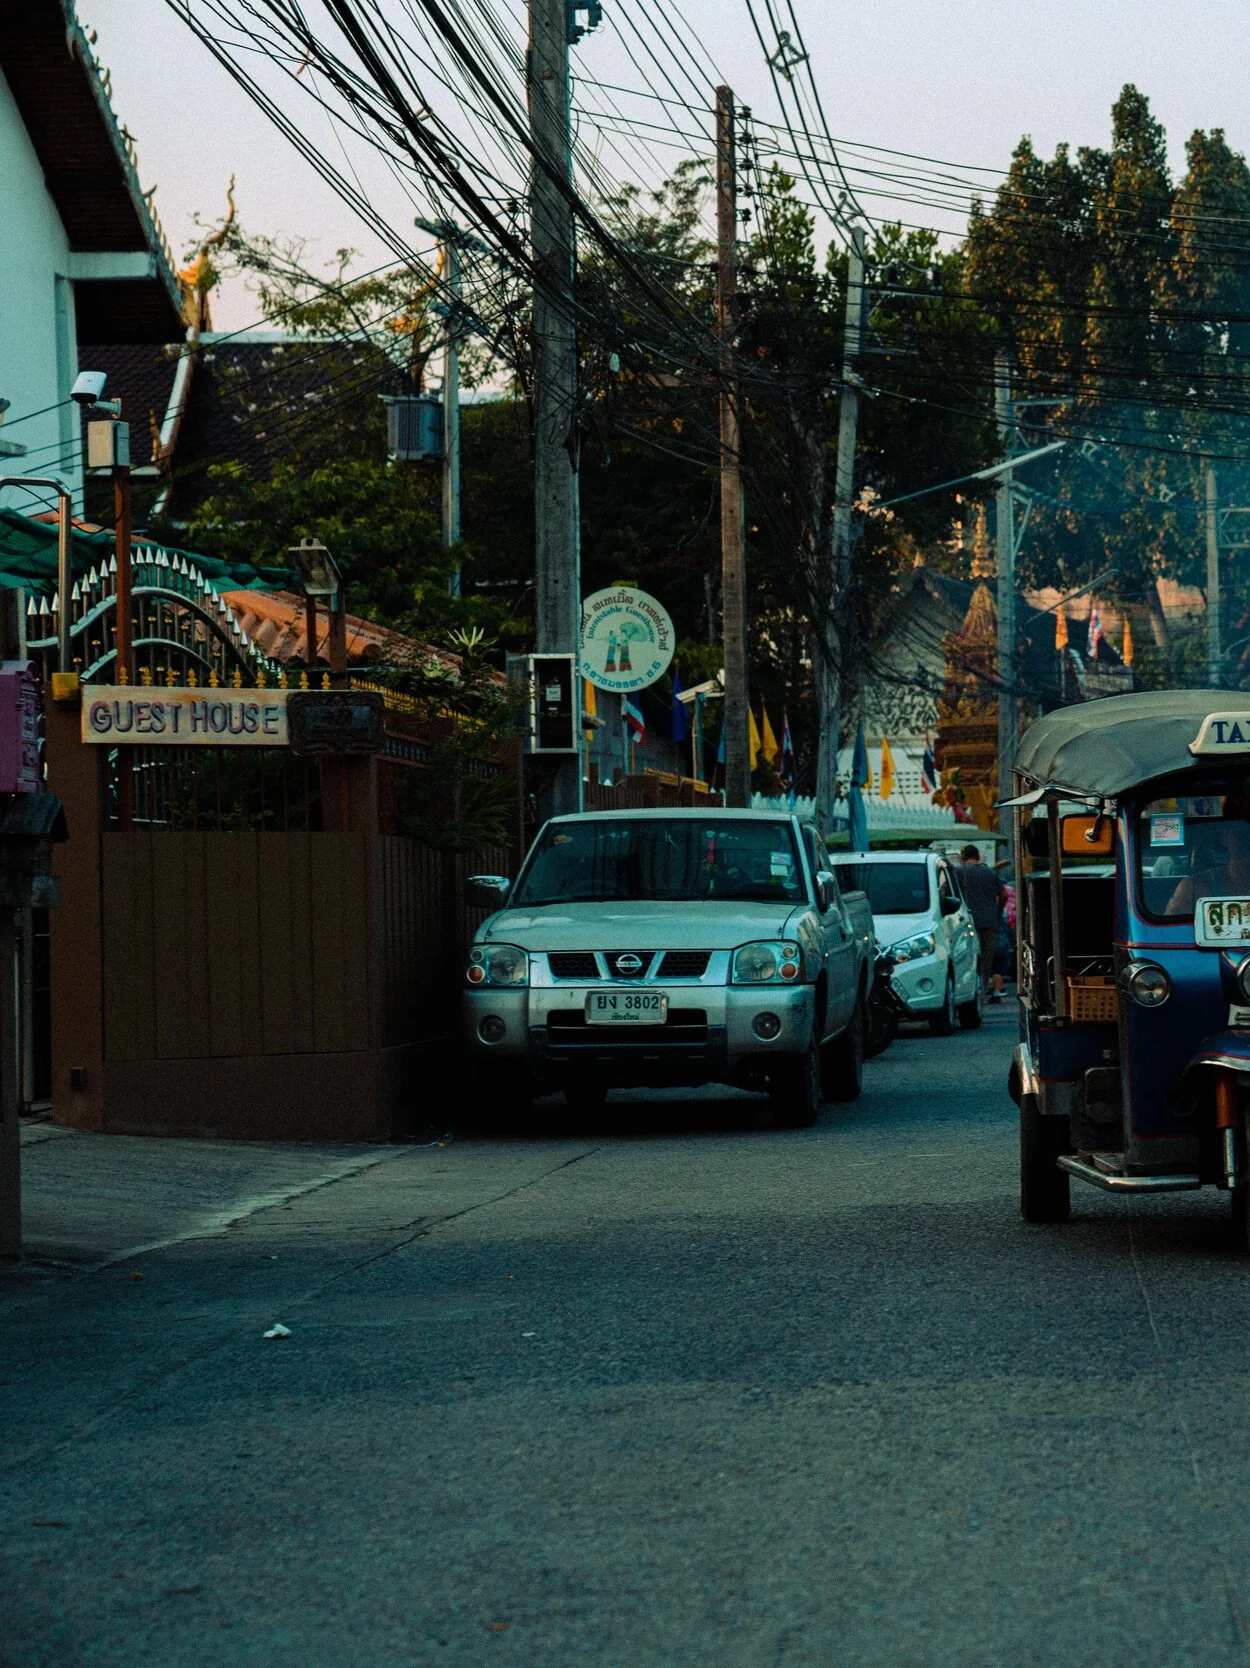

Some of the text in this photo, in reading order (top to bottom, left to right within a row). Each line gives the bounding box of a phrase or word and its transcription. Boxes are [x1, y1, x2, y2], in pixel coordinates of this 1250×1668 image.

[625, 605, 656, 644] Guesthouse
[90, 701, 279, 734] GUEST HOUSE
[597, 996, 659, 1009] ยง 3802
